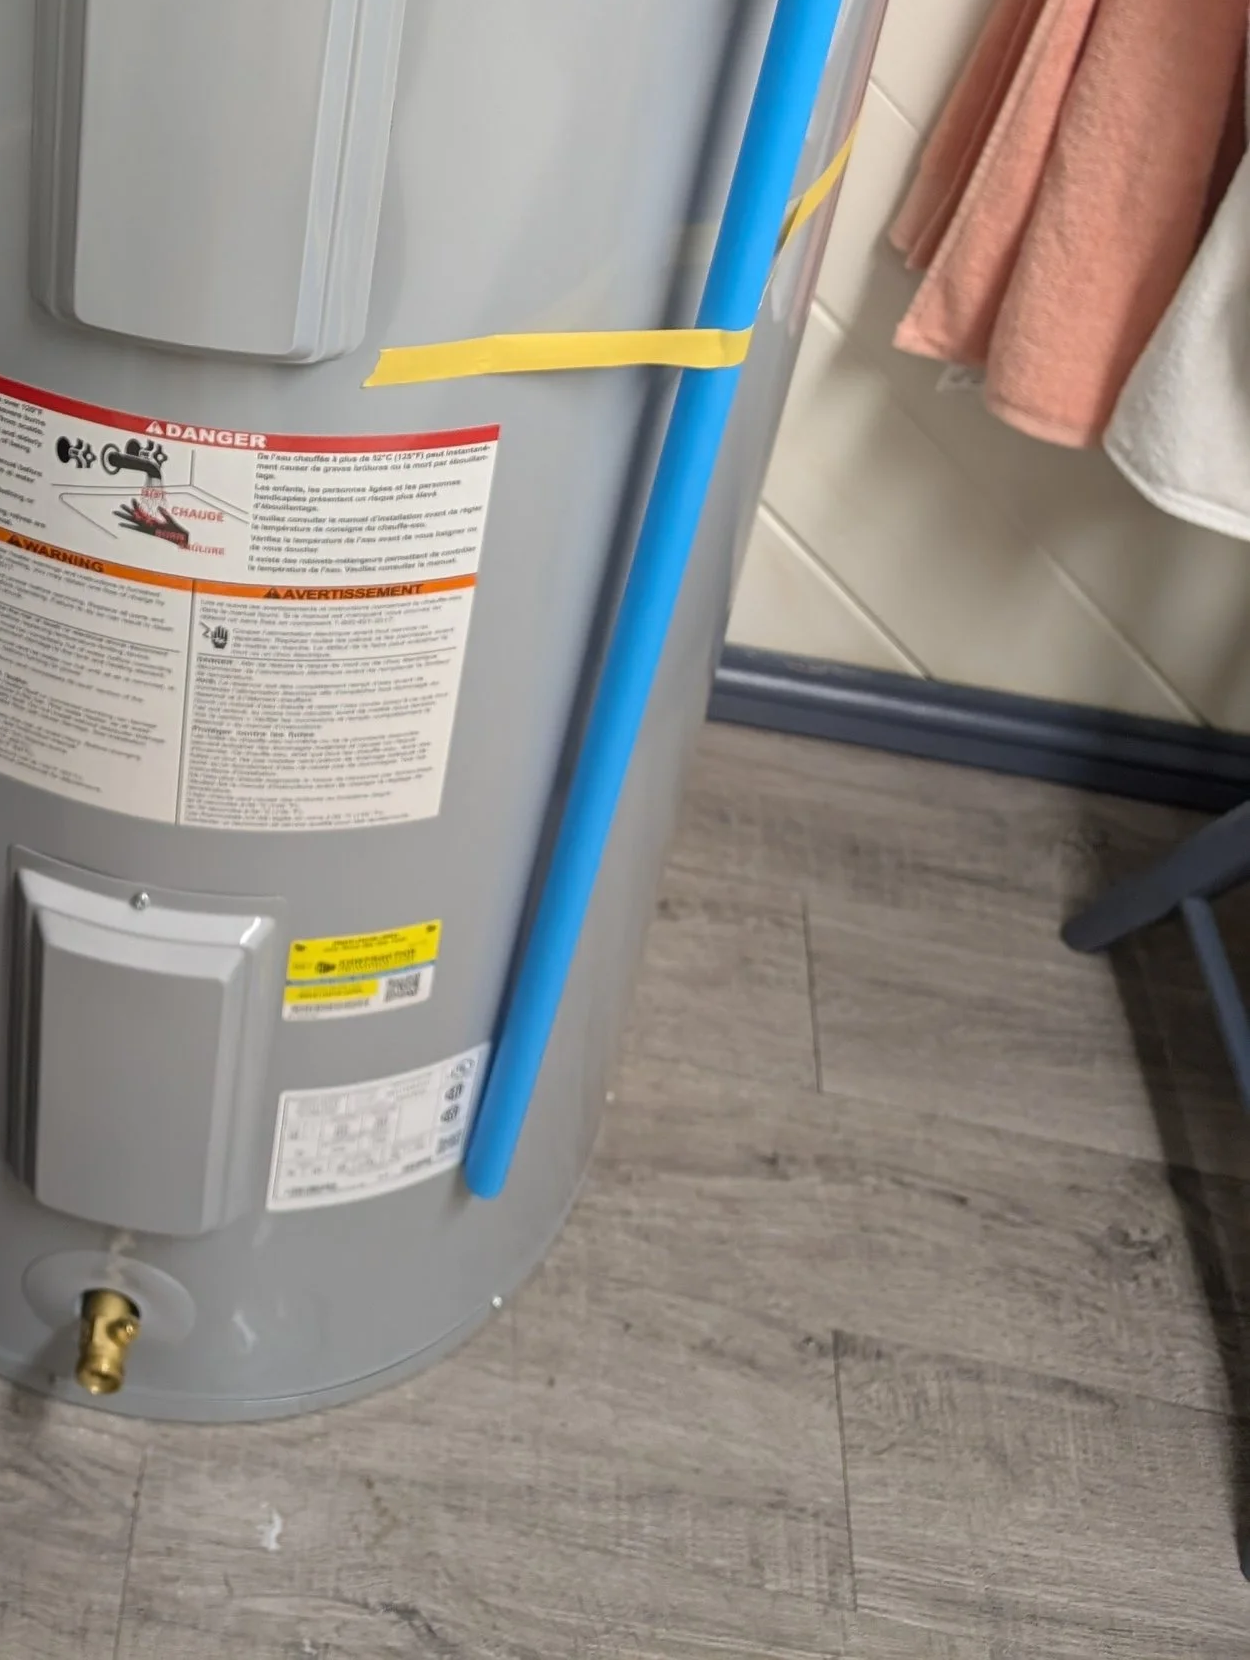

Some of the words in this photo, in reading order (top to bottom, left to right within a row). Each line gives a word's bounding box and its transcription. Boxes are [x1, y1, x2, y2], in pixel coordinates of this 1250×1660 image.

[164, 423, 268, 449] DANGER
[171, 506, 224, 522] CHAUDE
[23, 540, 104, 573] WARNING
[283, 583, 424, 600] AVERTISSEMENT
